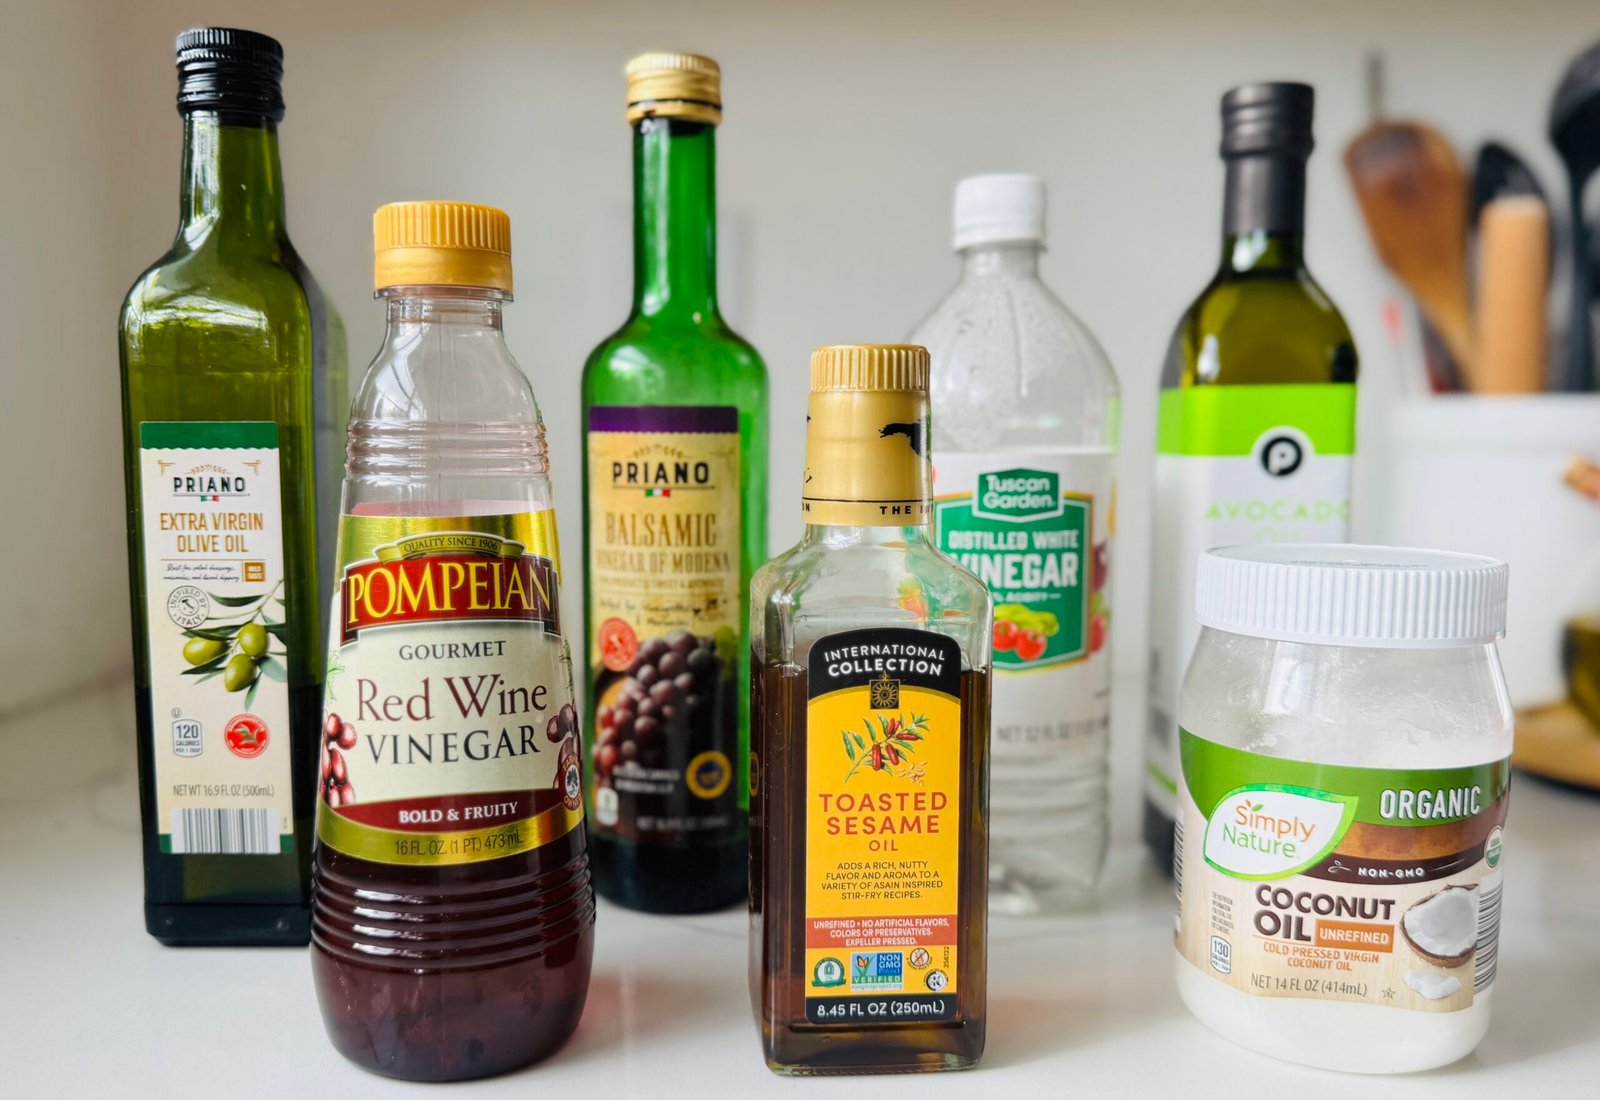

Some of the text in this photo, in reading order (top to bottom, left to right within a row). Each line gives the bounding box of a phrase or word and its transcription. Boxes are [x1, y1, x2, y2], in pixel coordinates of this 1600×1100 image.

[612, 461, 709, 484] PRIANO
[173, 476, 246, 493] PRIANO
[985, 474, 1051, 493] Tuscan
[879, 505, 912, 515] THE
[982, 492, 1053, 510] Garden
[160, 512, 264, 531] EXTRA VIRGIN
[605, 512, 717, 547] BALSAMIC
[177, 534, 250, 553] OLIVE OIL
[403, 537, 498, 552] QUALITY SINCE 1906
[948, 529, 1079, 550] DISTILLED WHITE
[650, 552, 665, 574] OF
[672, 552, 731, 574] MODENA
[170, 588, 200, 608] INSPIRED
[348, 562, 551, 624] POMPEIAN
[177, 614, 201, 626] ITALY
[399, 640, 506, 661] GOURMET
[824, 644, 945, 662] INTERNATIONAL
[828, 658, 942, 677] COLLECTION
[356, 673, 548, 722] Red Wine
[176, 724, 199, 739] 120
[365, 725, 541, 764] VINEGAR
[173, 784, 275, 798] NET WT 16.9 FL OZ (500mL)
[819, 792, 947, 813] TOASTED
[1380, 786, 1481, 819] ORGANIC
[399, 801, 519, 824] BOLD & FRUITY
[826, 815, 940, 835] SESAME
[1235, 803, 1316, 842] Simply
[394, 840, 409, 855] 16
[429, 840, 448, 855] OZ.
[484, 834, 506, 849] 473
[507, 829, 523, 846] mL
[868, 839, 899, 852] OIL
[1222, 822, 1297, 858] Nature
[826, 870, 940, 880] FLAVOR AND AROMA TO A
[837, 861, 928, 871] ADDS A RICH, NUTTY
[1358, 866, 1426, 878] NON-GMO
[821, 882, 858, 890] VARIETY
[873, 881, 900, 889] ASAIN
[902, 880, 944, 889] INSPIRED
[841, 891, 923, 900] STIR-FRY RECIPES.
[1255, 884, 1396, 920] COCONUT
[814, 917, 950, 929] UNREFINED NO ARTIFICIAL FLAVORS,
[1253, 909, 1312, 943] OIL
[1319, 927, 1390, 945] UNREFINED
[830, 927, 933, 938] COLORS OR PRESERVATIVES.
[845, 937, 917, 947] EXPELLER PRESSED.
[1213, 940, 1229, 958] 130
[1263, 942, 1289, 955] COLD
[1292, 946, 1341, 960] PRESSED
[879, 954, 900, 962] NON
[879, 961, 901, 969] GMO
[1287, 958, 1352, 971] COCONUT OIL
[853, 976, 900, 984] VERIFIED
[1251, 972, 1368, 997] NET 14 FL OZ (414mL)
[817, 1000, 945, 1017] 8.45 FL OZ (250mL)
